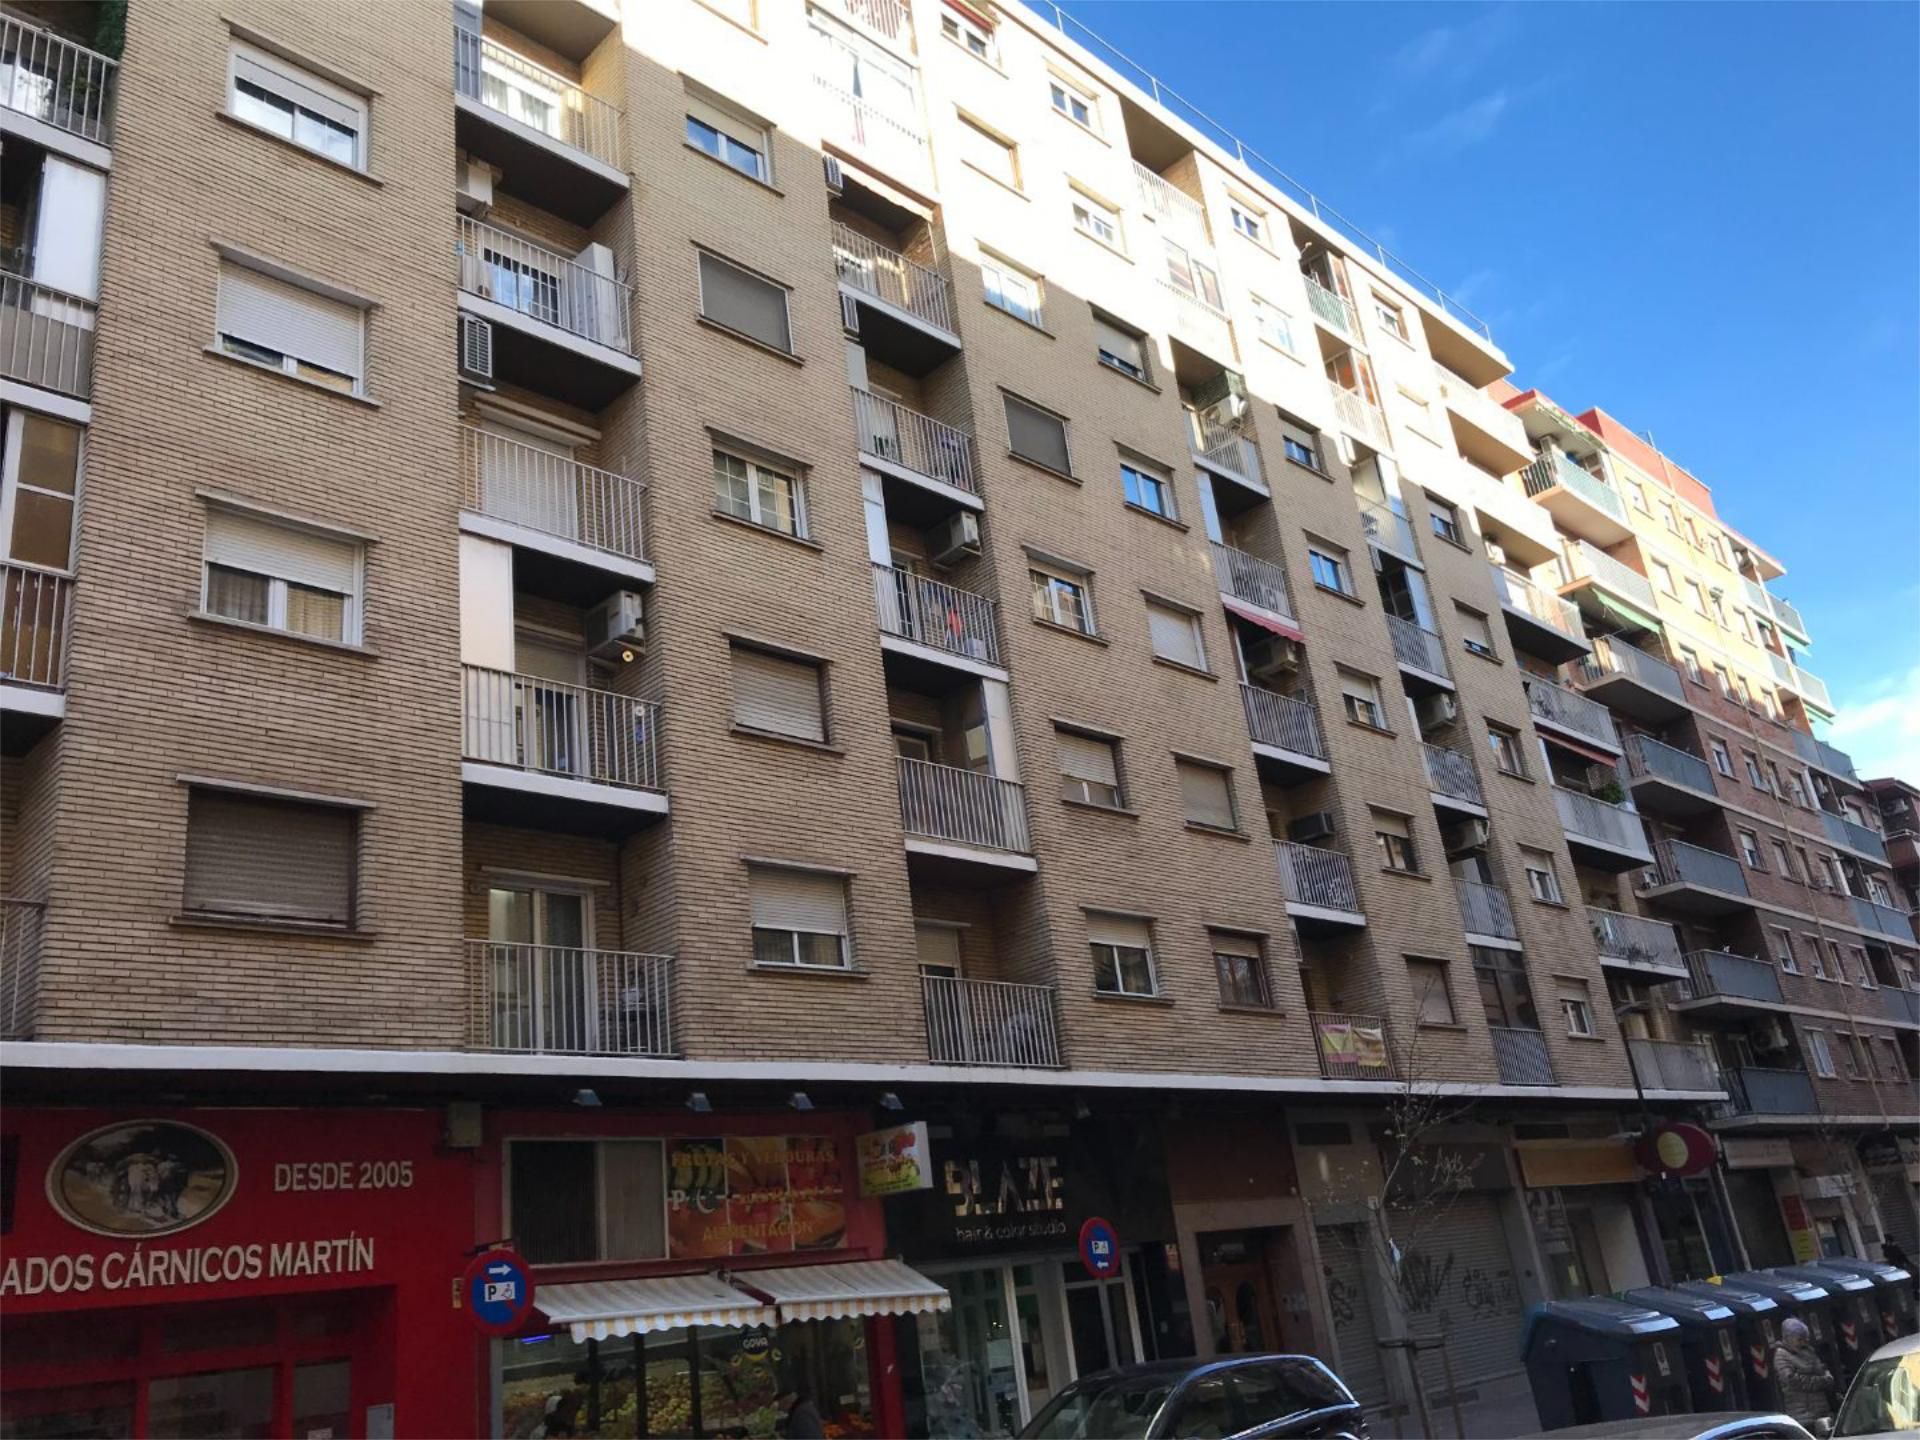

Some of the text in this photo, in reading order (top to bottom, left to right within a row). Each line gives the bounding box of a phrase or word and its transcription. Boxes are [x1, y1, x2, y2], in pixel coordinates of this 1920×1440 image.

[672, 1150, 835, 1167] FRUTAS Y VERDURAS
[274, 1160, 413, 1192] DESDE 2005
[955, 1226, 983, 1242] hair
[1028, 1220, 1066, 1236] studio
[0, 1231, 375, 1296] ADOS CÁRNICOS MARTÍN
[488, 1285, 497, 1301] P
